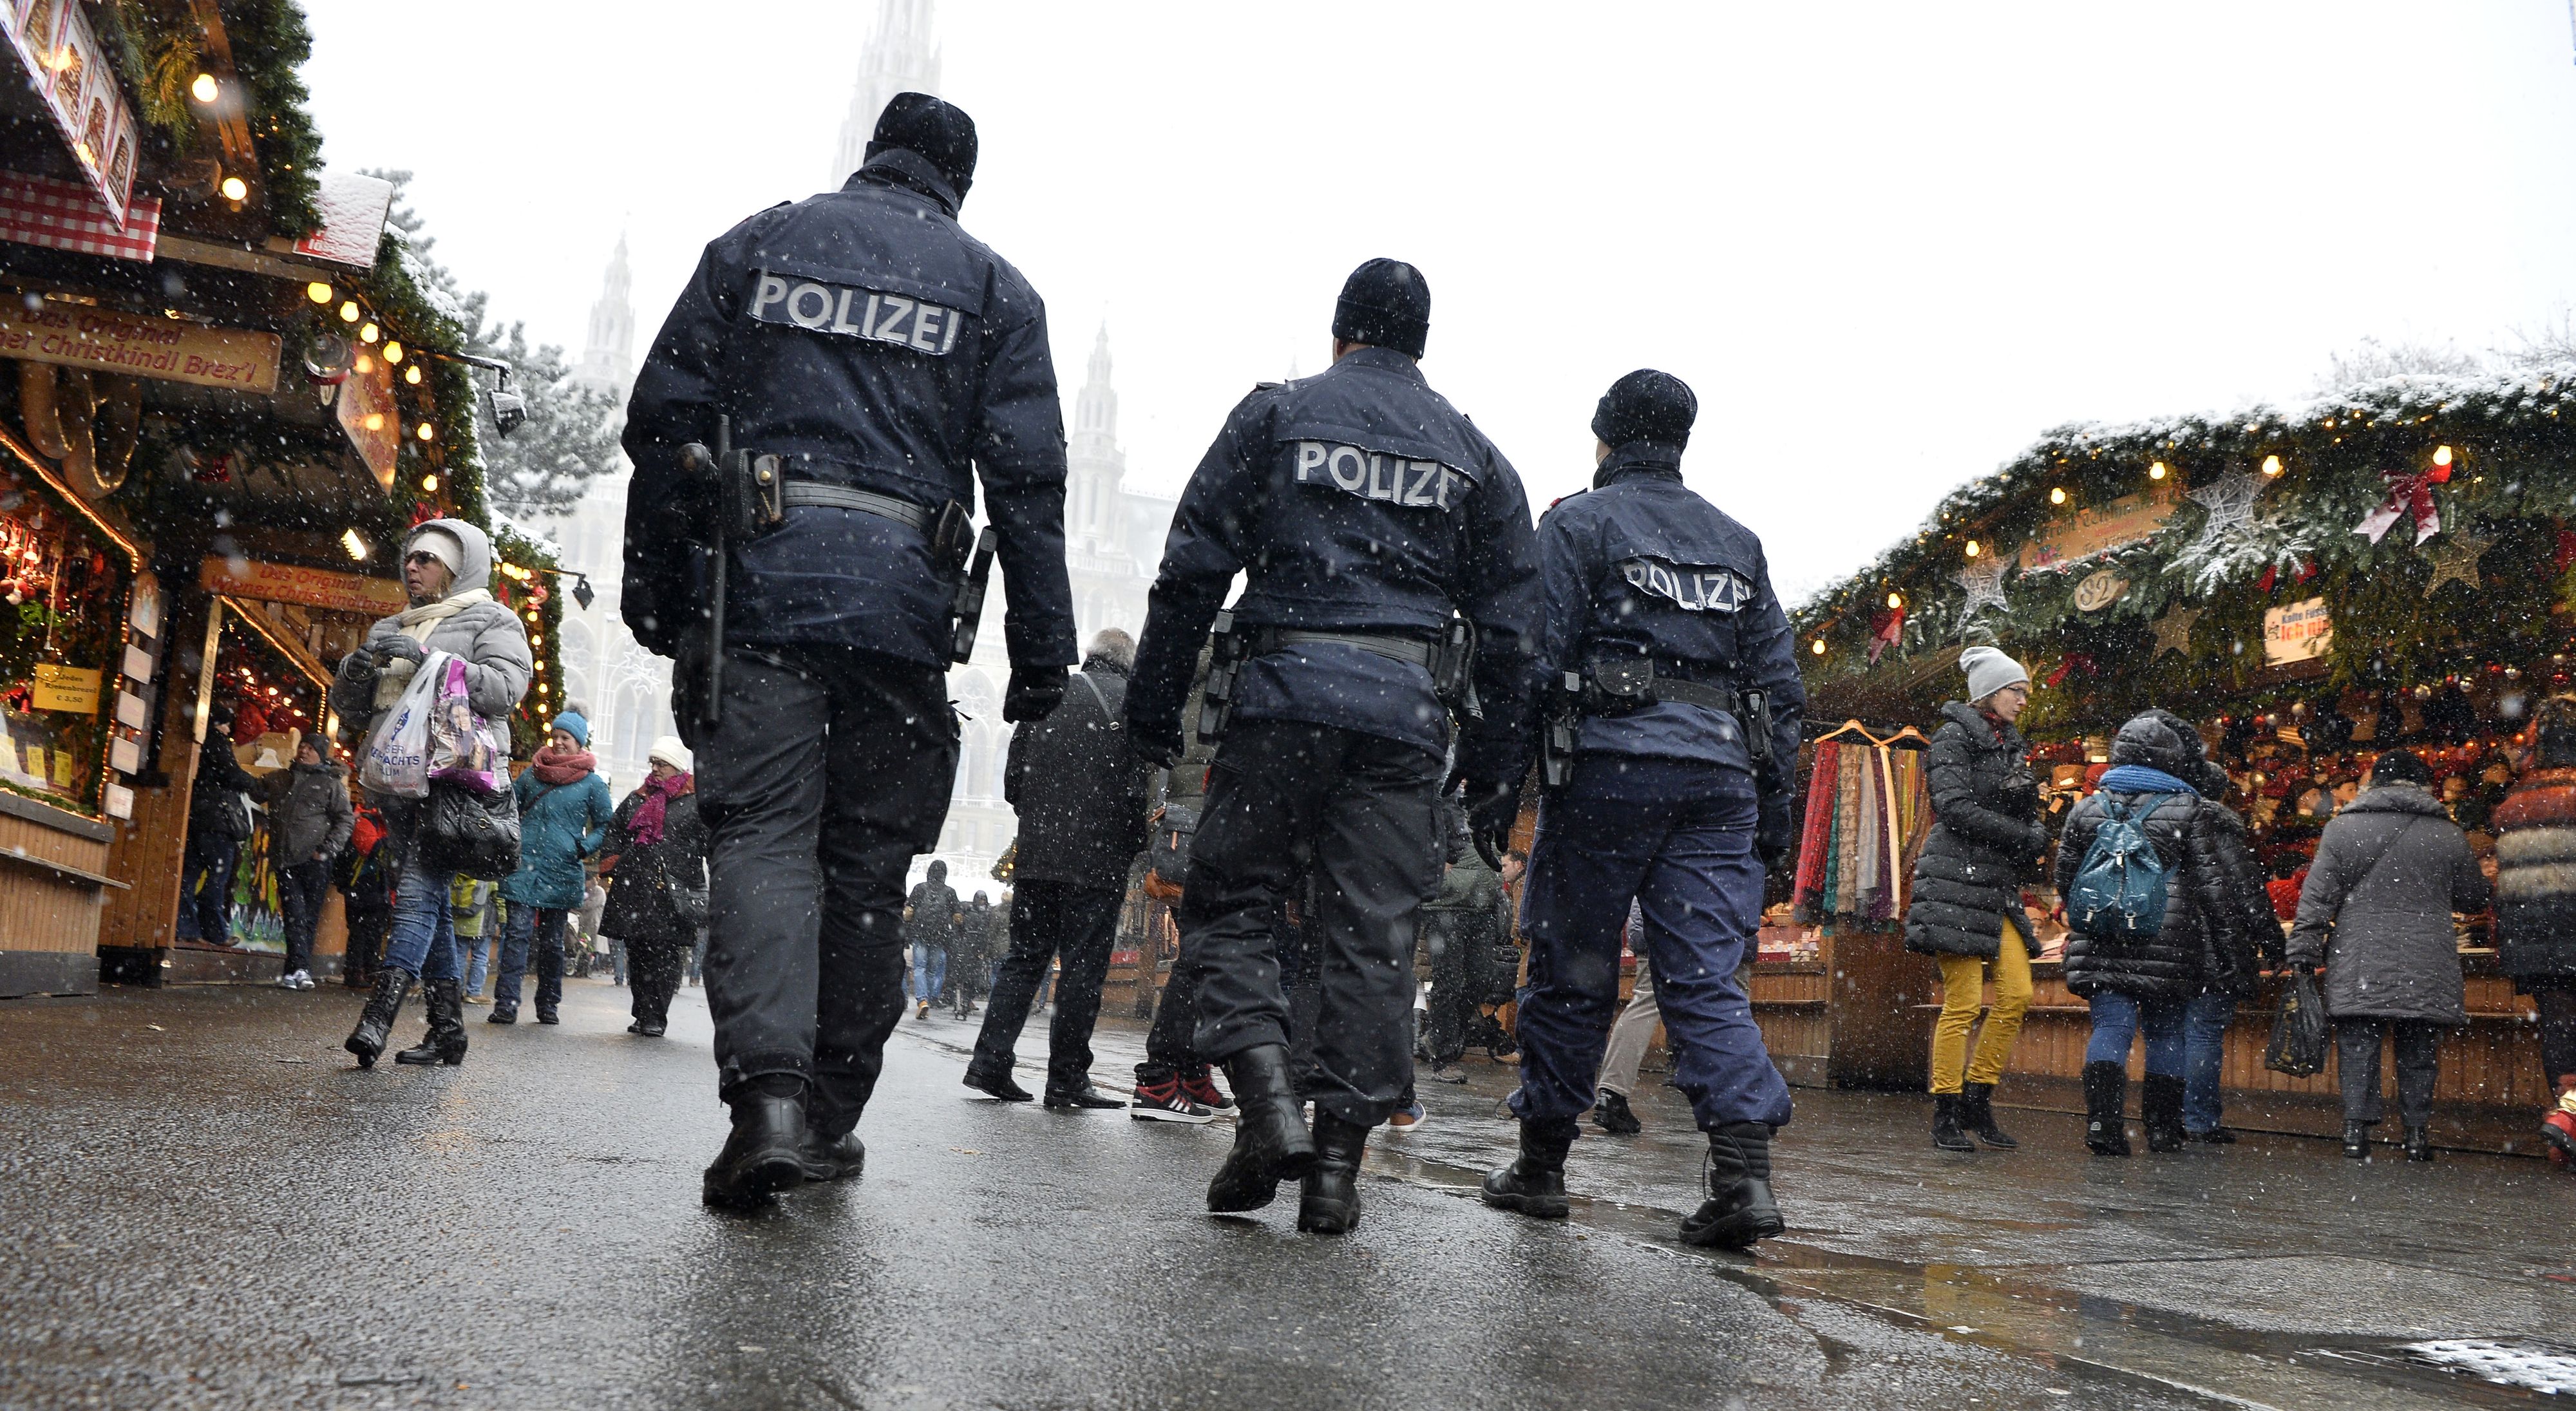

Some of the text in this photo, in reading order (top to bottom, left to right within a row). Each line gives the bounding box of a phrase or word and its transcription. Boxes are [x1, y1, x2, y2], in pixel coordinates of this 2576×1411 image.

[750, 274, 963, 354] POLIZEI
[78, 314, 183, 346] Original
[41, 334, 180, 372] Christkindl
[184, 355, 257, 383] Brez'l
[260, 565, 363, 591] Das Original
[2080, 575, 2110, 606] 82
[2281, 623, 2304, 641] Ich
